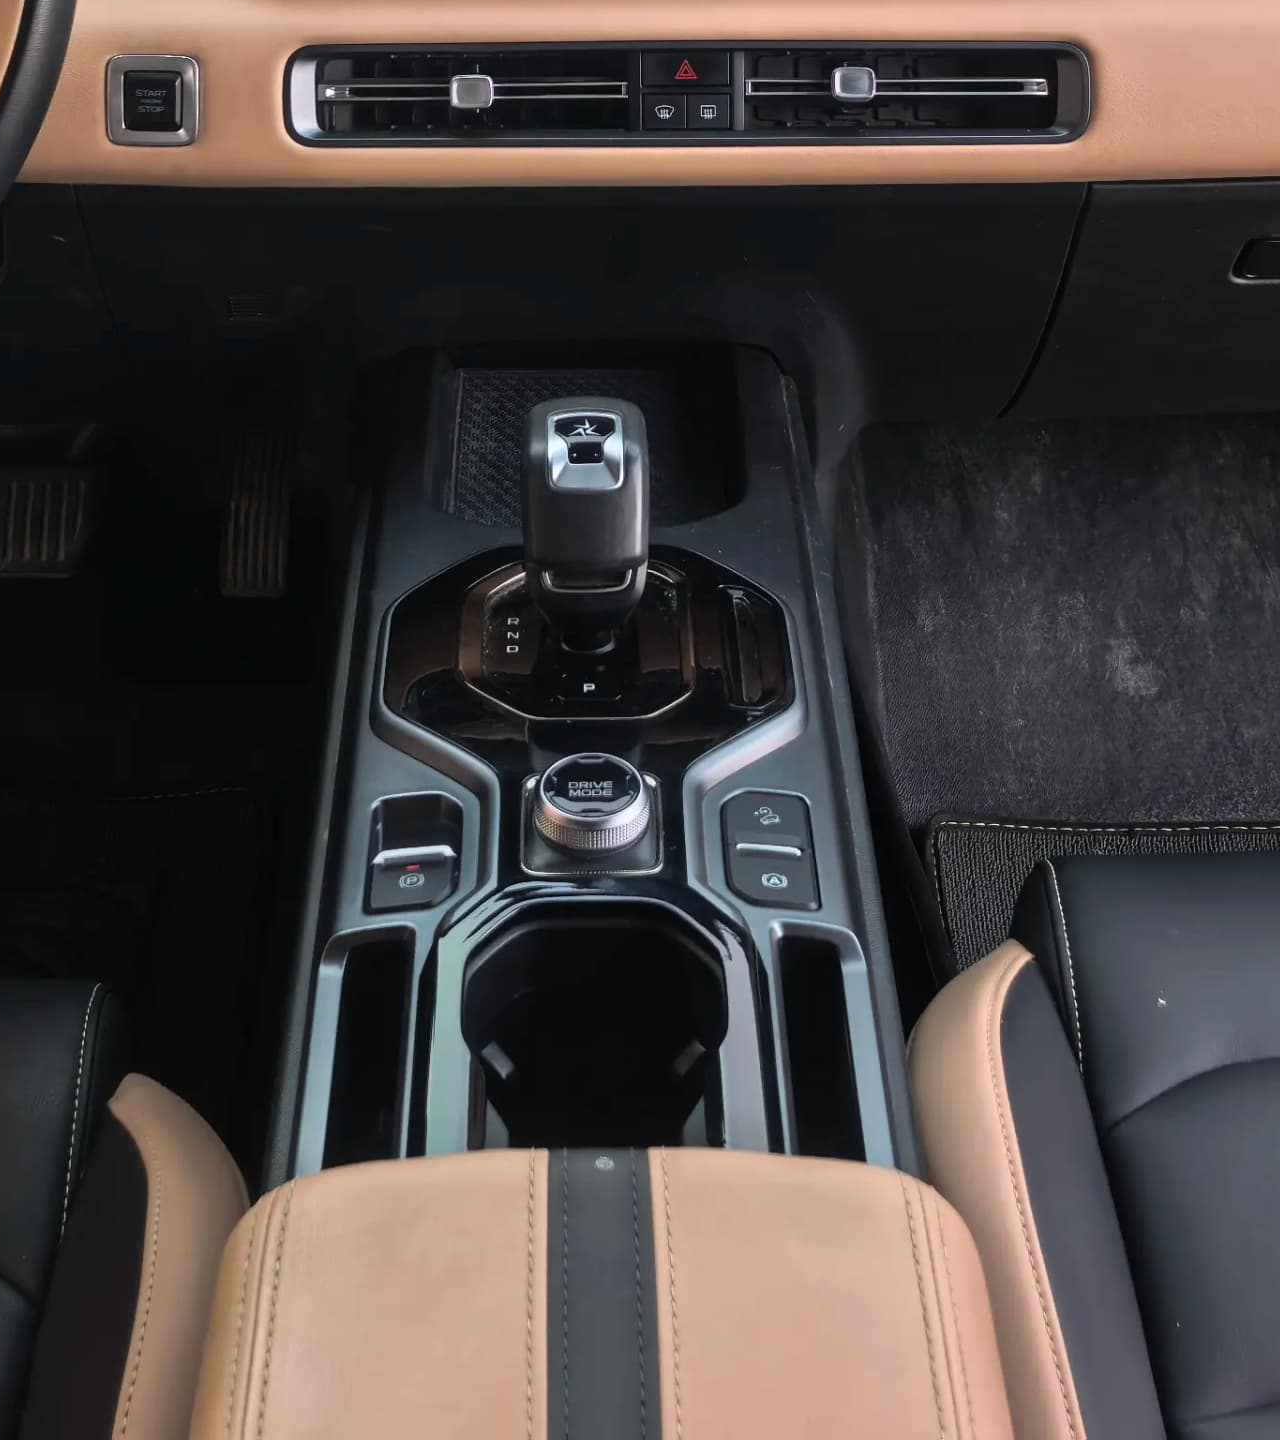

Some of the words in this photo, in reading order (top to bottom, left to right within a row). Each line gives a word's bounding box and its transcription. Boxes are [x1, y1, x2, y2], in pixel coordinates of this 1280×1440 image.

[507, 617, 520, 625] R
[507, 631, 519, 639] N
[506, 645, 519, 653] D
[583, 683, 595, 693] P
[568, 780, 613, 789] DRIVE
[569, 788, 613, 797] MODE
